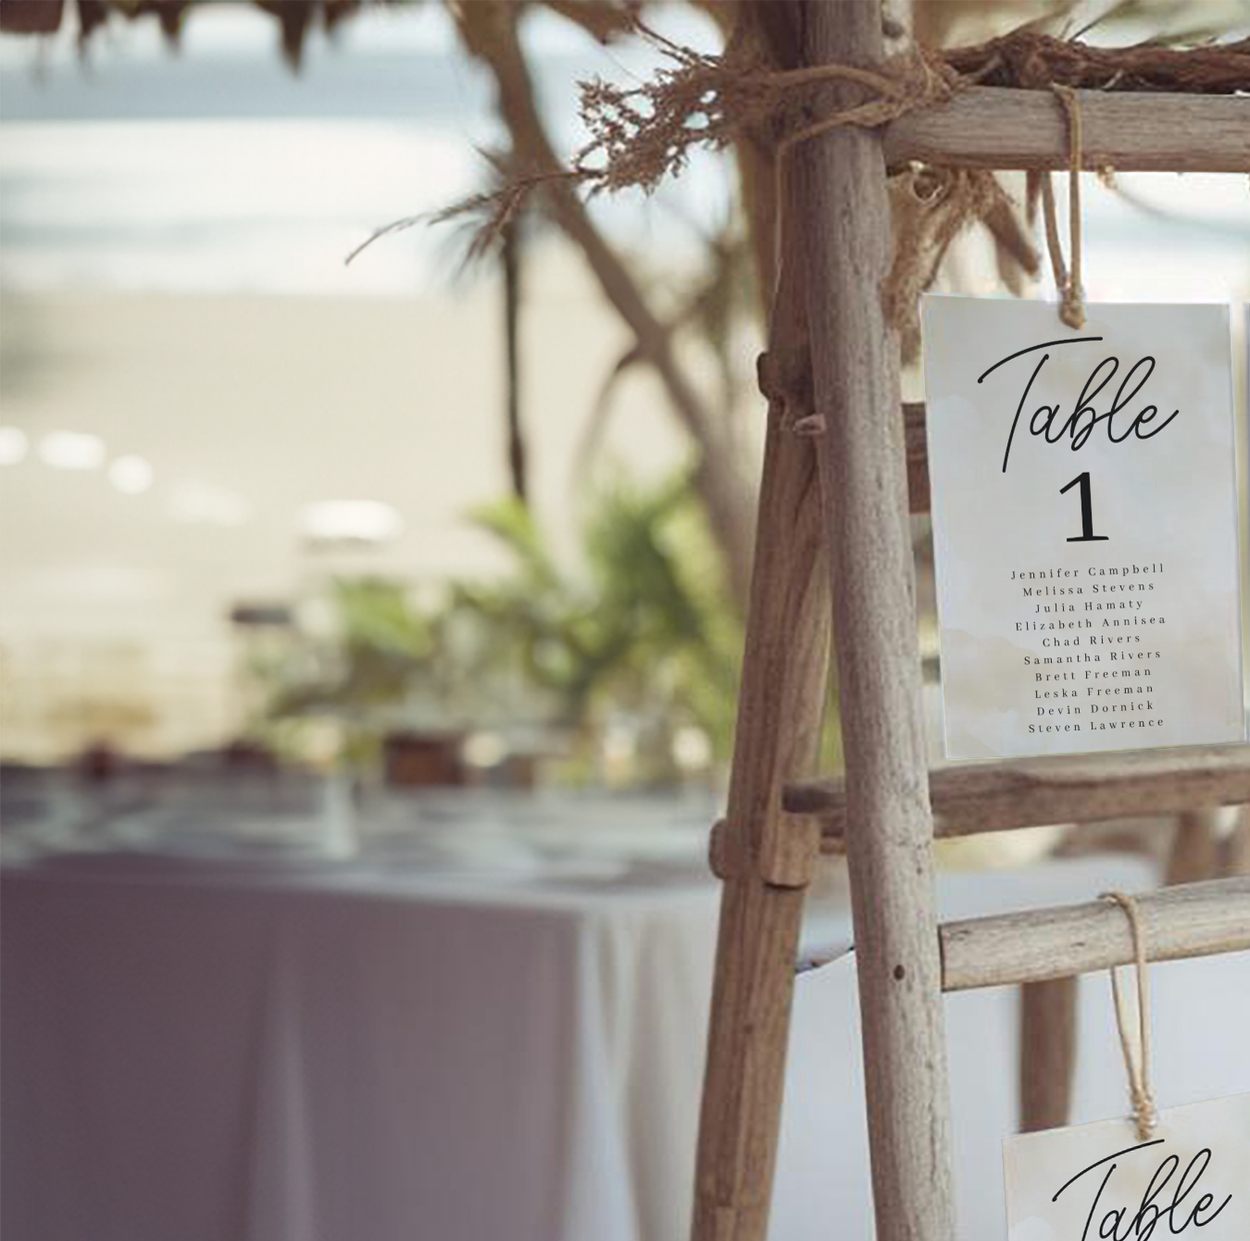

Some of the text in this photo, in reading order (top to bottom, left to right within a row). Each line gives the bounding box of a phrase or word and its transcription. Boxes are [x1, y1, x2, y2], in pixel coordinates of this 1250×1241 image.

[977, 336, 1179, 473] Table
[1059, 471, 1109, 543] 1
[1011, 563, 1163, 580] Jennifer Campbell
[1023, 583, 1154, 597] Melissa Stevens
[1035, 600, 1143, 614] Julia Hamaty
[1015, 616, 1165, 631] Elizabeth Annisea
[1042, 635, 1140, 648] Chad Rivers
[1024, 651, 1161, 665] Samantha Rivers
[1035, 669, 1151, 682] Brett Freeman
[1035, 686, 1153, 699] Leska Freeman
[1037, 700, 1153, 716] Devin Dornick
[1028, 719, 1163, 733] Steven Lawrence
